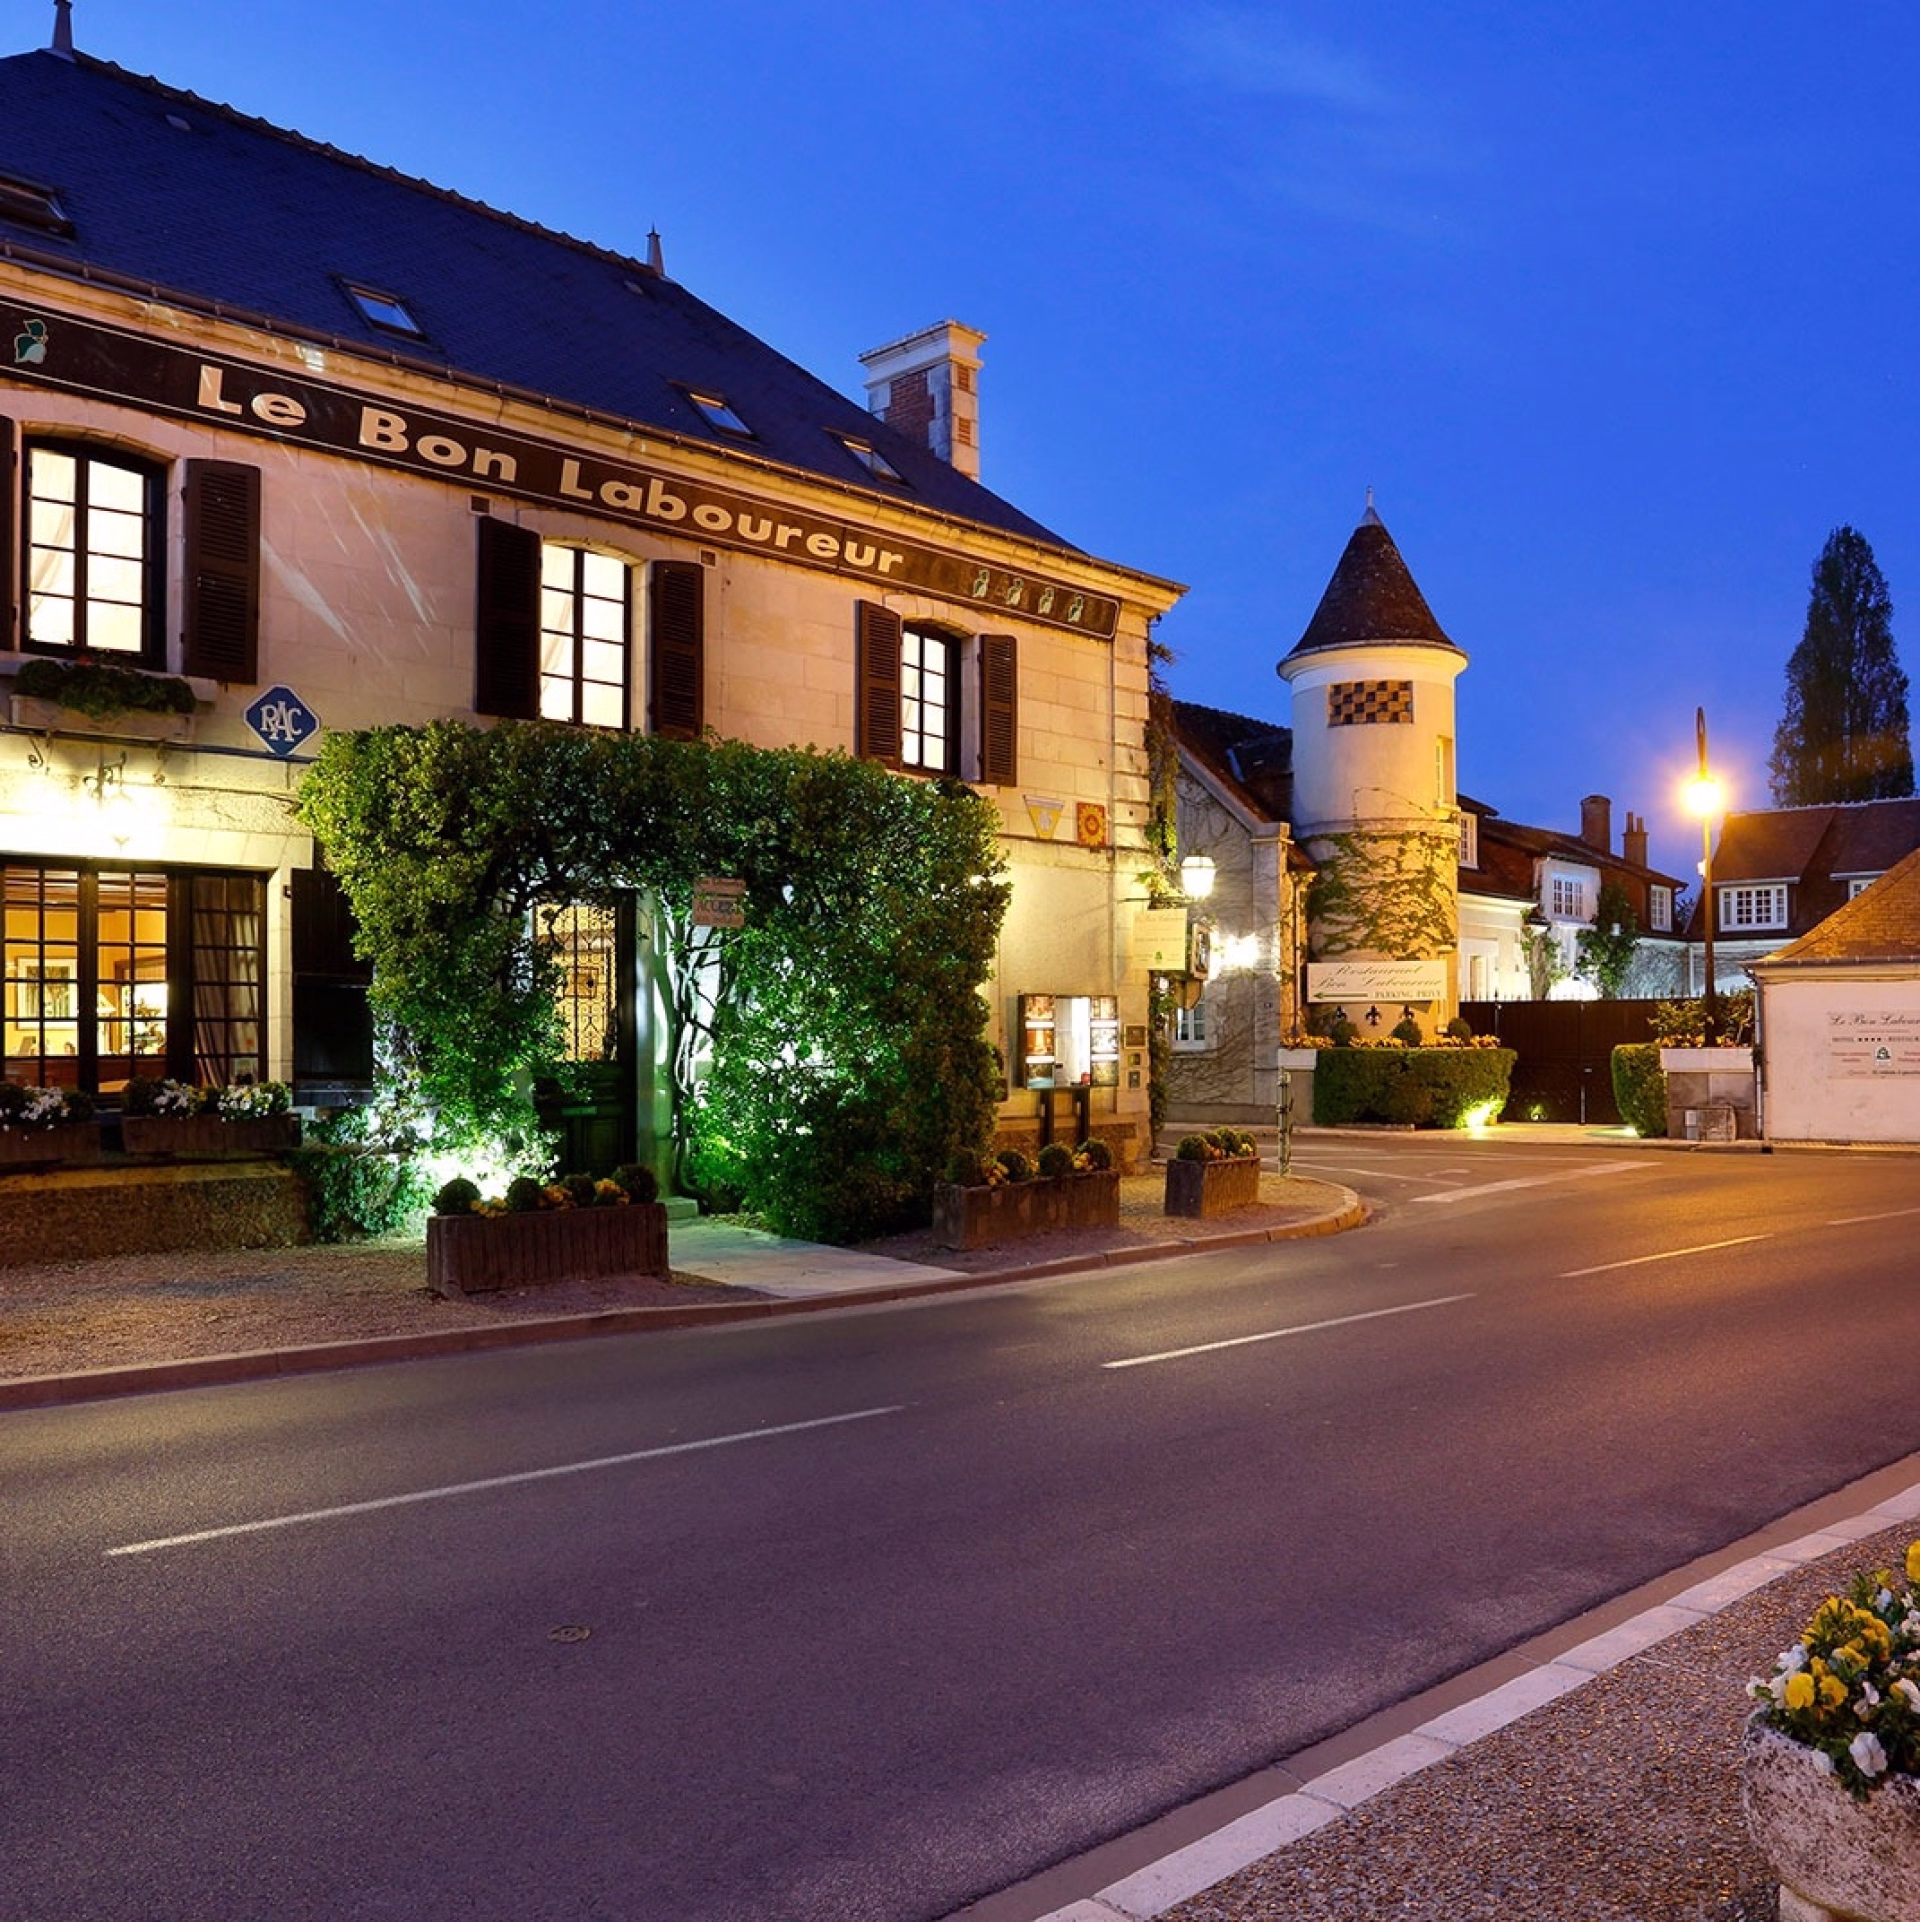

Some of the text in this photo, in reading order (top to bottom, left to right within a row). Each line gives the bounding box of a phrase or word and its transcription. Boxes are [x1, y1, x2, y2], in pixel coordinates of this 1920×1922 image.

[198, 363, 904, 573] Le Bon Laboureur
[260, 700, 302, 742] RAC
